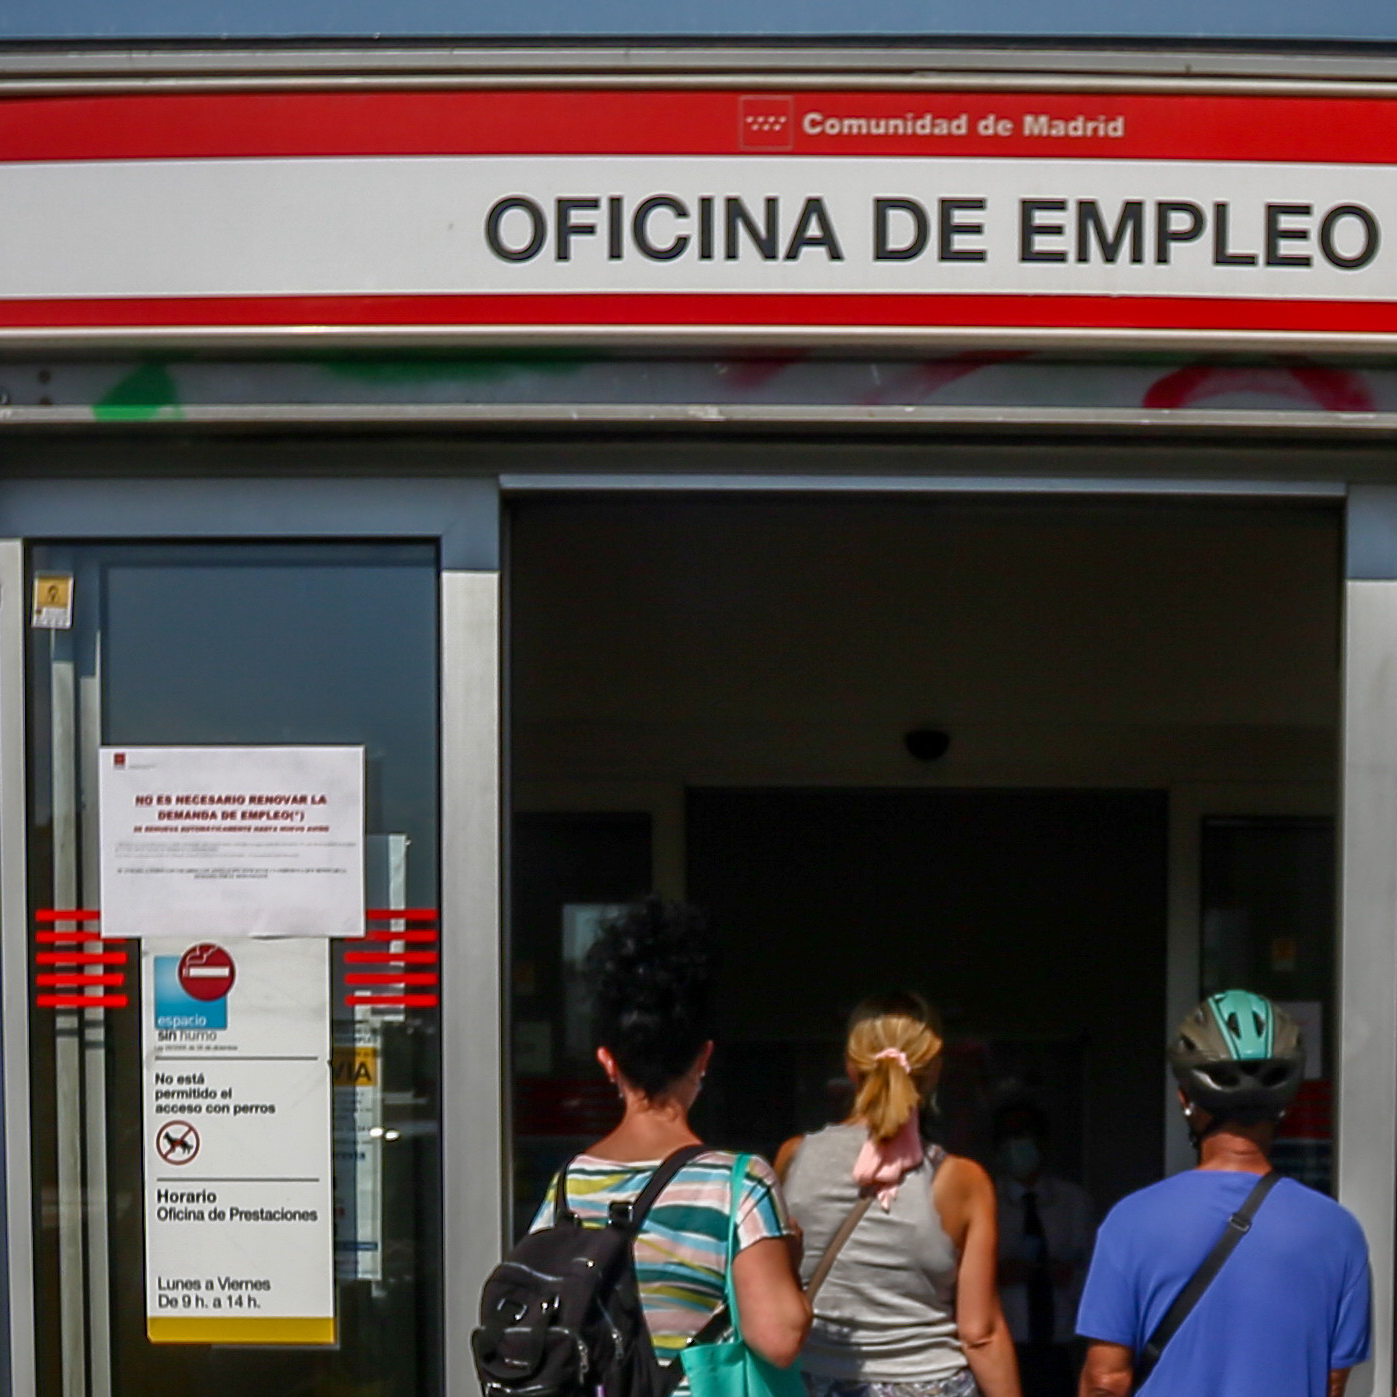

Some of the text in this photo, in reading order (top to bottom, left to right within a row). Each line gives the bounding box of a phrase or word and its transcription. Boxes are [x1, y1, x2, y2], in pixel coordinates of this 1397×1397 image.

[802, 111, 1125, 138] Comunidad de Madrid
[484, 194, 1381, 270] OFICINA DE EMPLEO
[134, 794, 328, 806] NO ES NECESARIO RENOVAR LA
[158, 810, 218, 821] DEMANDA
[221, 810, 237, 821] DE
[158, 1013, 207, 1029] espacio
[158, 1027, 217, 1041] sin humo
[155, 1072, 205, 1085] No está
[155, 1087, 232, 1102] permitido el
[155, 1103, 276, 1117] acceso con perros
[157, 1188, 217, 1204] Horario
[157, 1206, 318, 1222] Oficina de Prestaciones
[158, 1276, 271, 1291] Lunes a Viernes
[158, 1294, 261, 1309] De 9 h. a 14 h.
